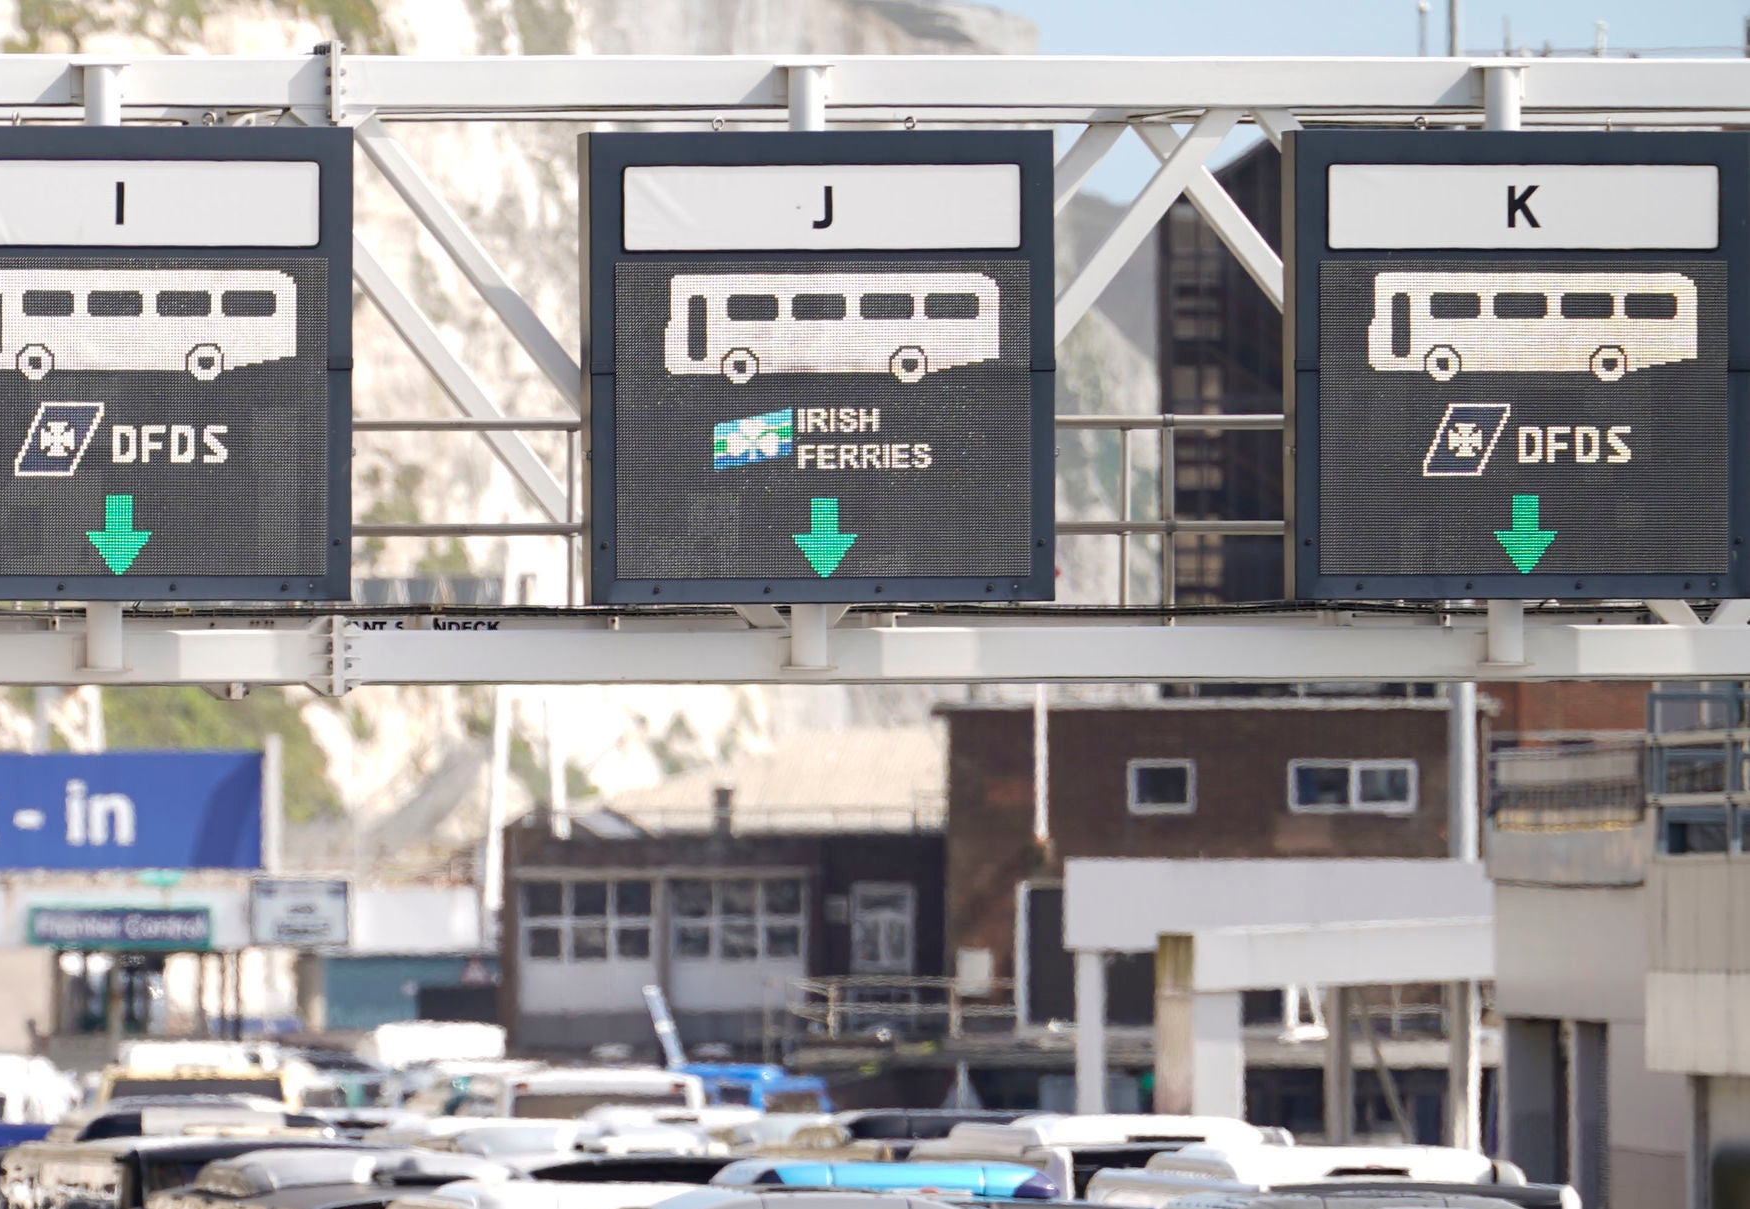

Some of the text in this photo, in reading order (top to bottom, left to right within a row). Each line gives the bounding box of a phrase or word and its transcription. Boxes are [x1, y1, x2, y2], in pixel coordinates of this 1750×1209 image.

[115, 181, 125, 225] I
[811, 185, 833, 230] J
[1506, 185, 1541, 229] K
[797, 407, 882, 433] IRISH
[112, 424, 229, 464] DFDS
[797, 443, 934, 470] FERRIES
[1517, 425, 1632, 464] DFDS
[65, 779, 137, 846] in
